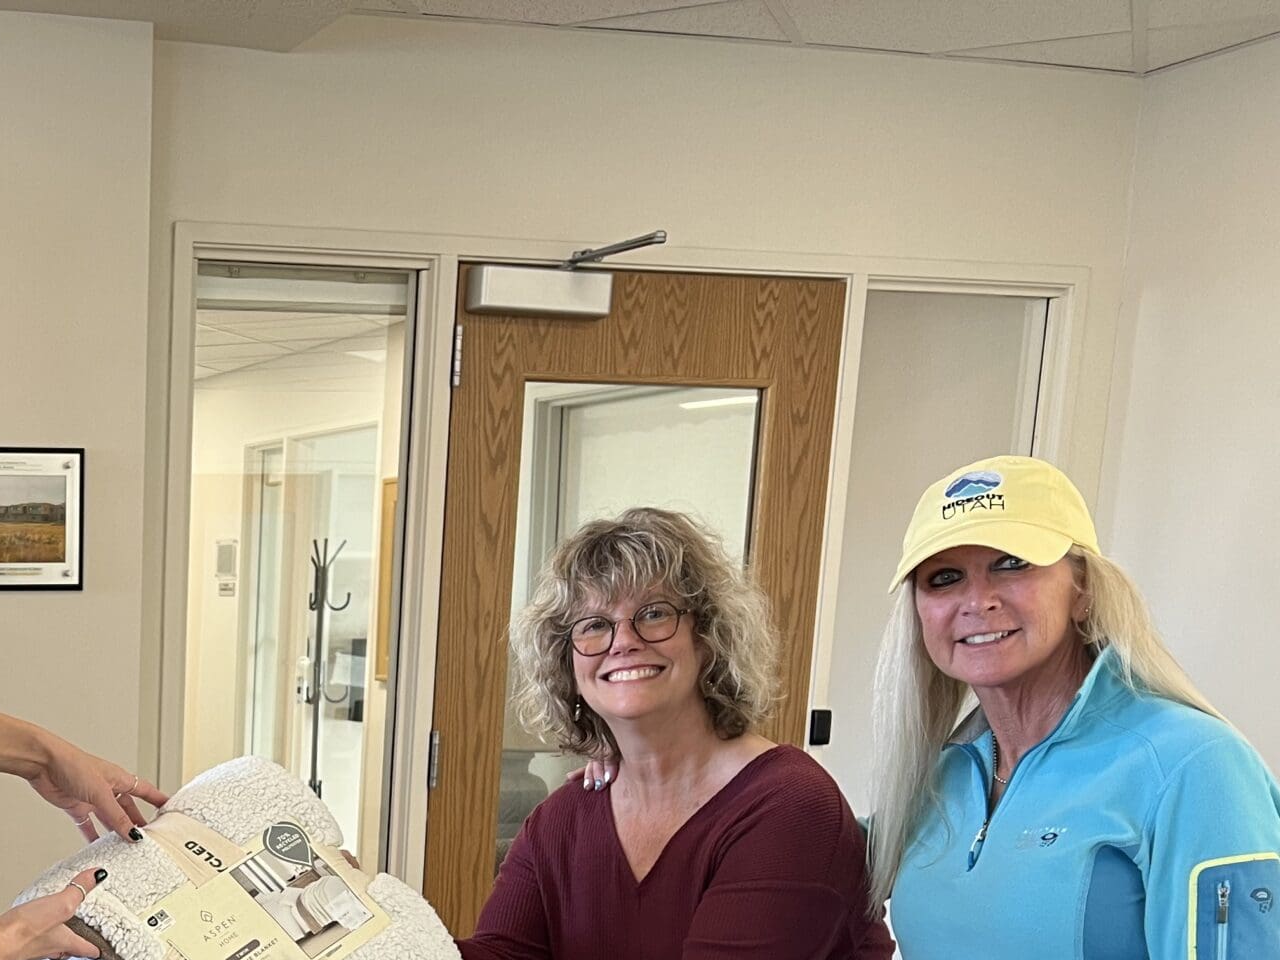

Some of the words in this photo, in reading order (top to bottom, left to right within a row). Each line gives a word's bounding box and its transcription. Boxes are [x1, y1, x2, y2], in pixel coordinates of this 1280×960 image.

[942, 493, 1004, 511] HIDEOUT
[942, 497, 1005, 520] UTAH
[276, 833, 300, 850] RECYCLED
[277, 832, 292, 842] 70%
[203, 915, 237, 942] ASPEN
[219, 931, 240, 948] HOME
[254, 938, 279, 958] BLANKET
